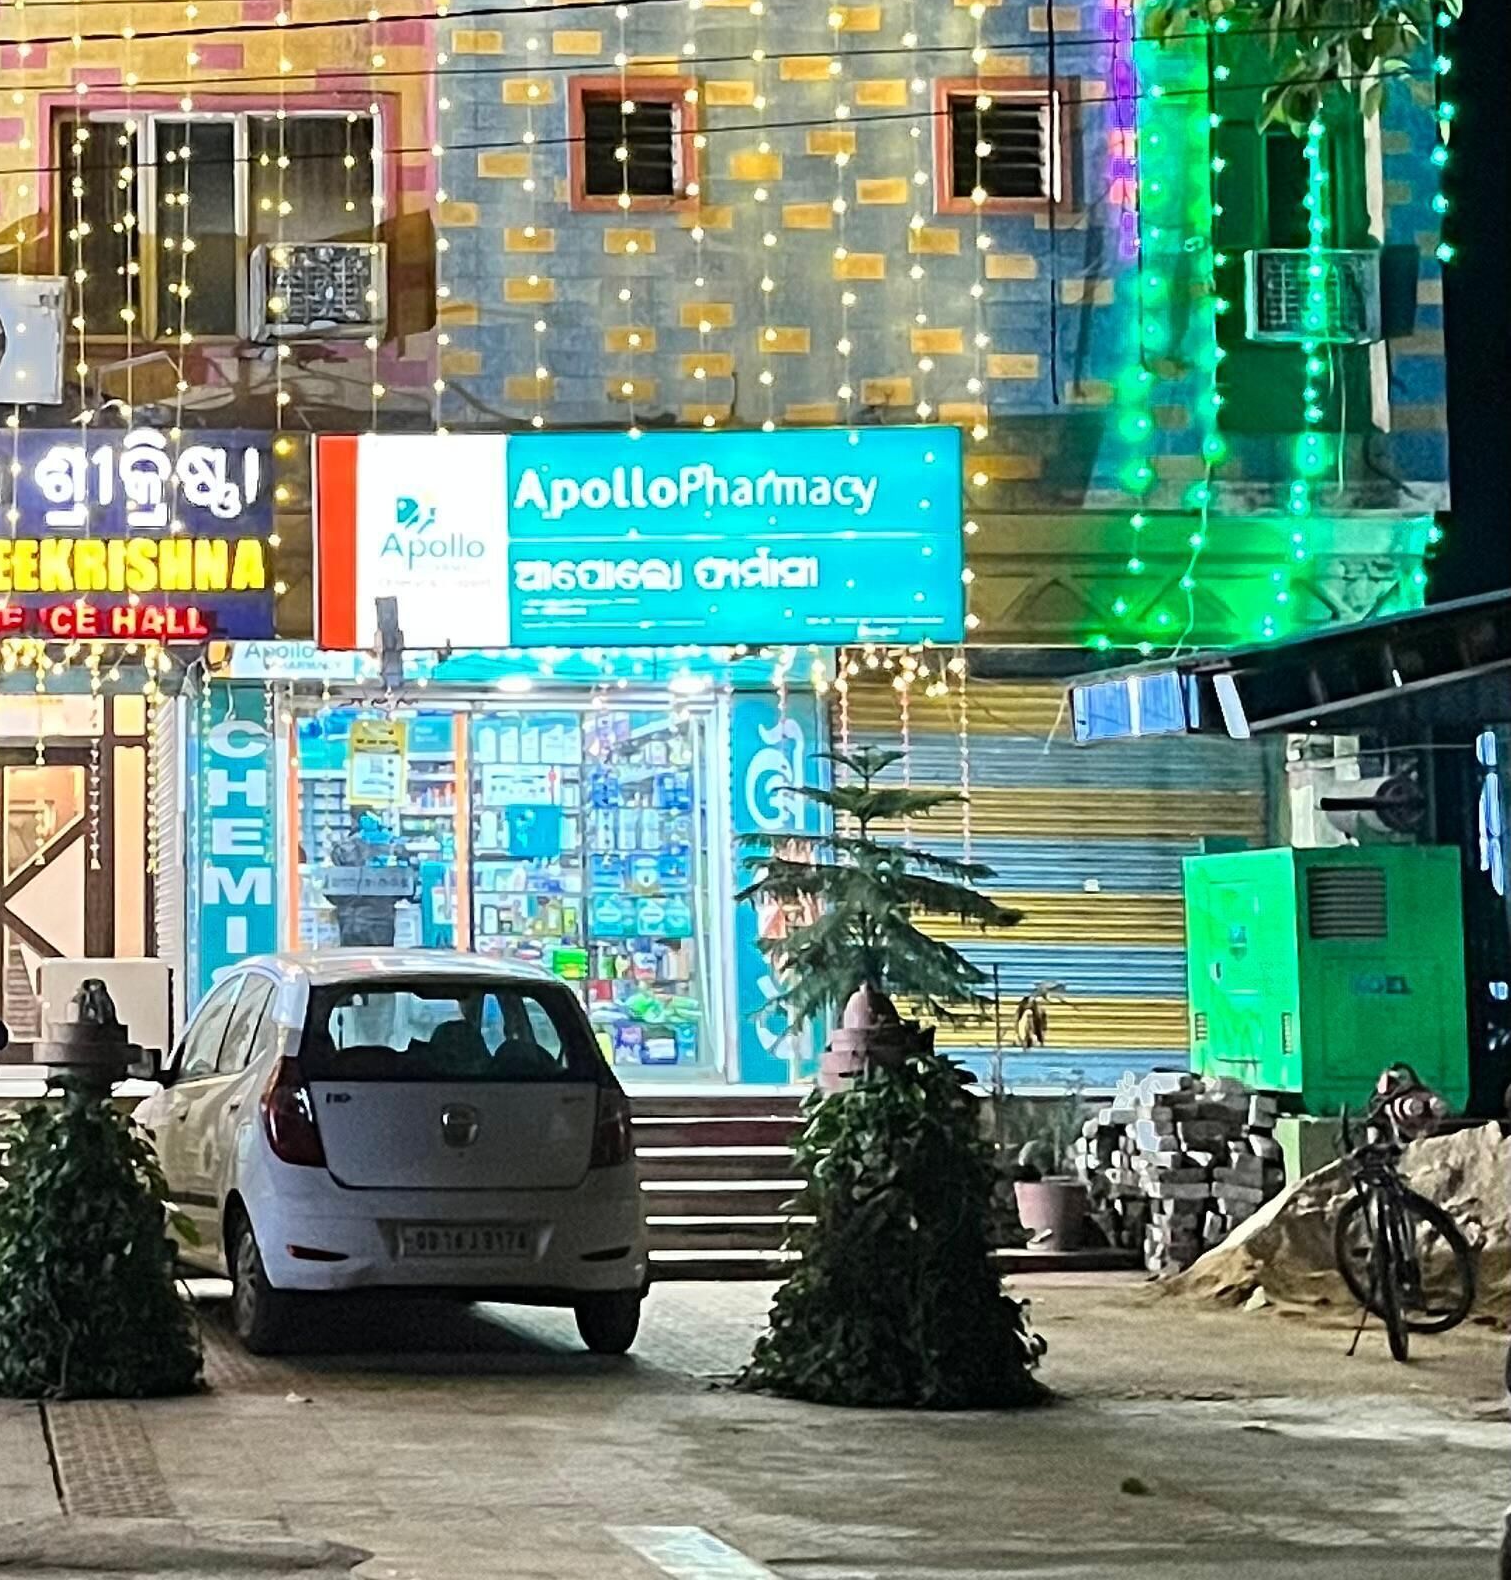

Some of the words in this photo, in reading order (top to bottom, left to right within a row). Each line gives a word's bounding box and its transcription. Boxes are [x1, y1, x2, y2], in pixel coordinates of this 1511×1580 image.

[380, 533, 484, 571] Apollo
[113, 604, 208, 636] HALL
[244, 641, 315, 670] Apollo
[202, 719, 272, 983] CHEMI
